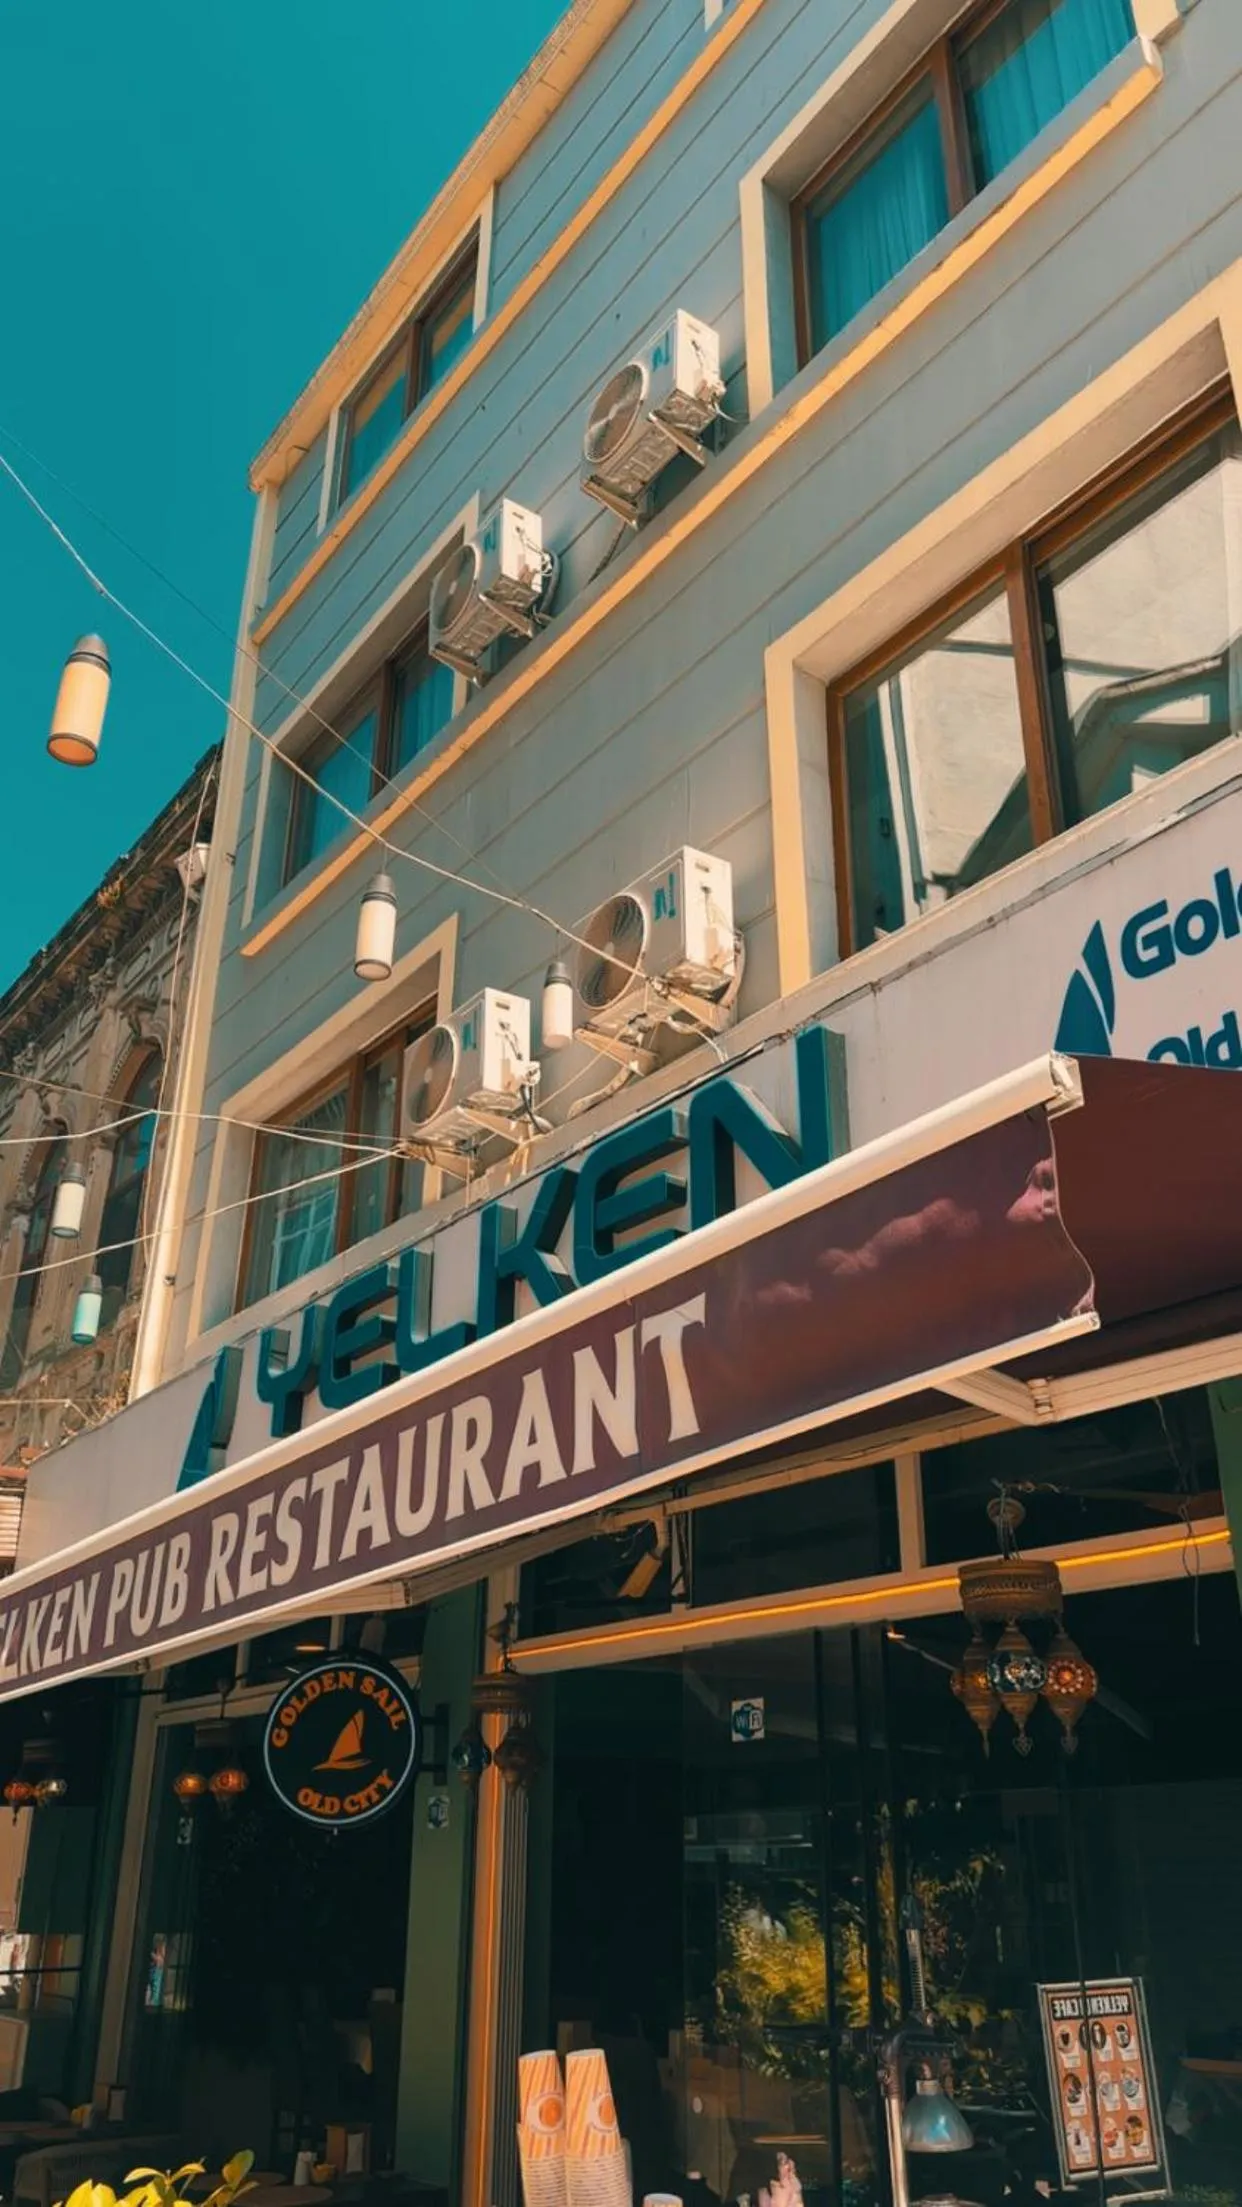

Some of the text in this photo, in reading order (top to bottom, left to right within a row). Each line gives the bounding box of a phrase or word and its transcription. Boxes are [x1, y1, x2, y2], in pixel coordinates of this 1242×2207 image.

[1121, 867, 1242, 980] Gol
[256, 1023, 846, 1438] YELKEN
[104, 1531, 191, 1648] PUB
[201, 1292, 706, 1614] RESTAURANT
[272, 1671, 406, 1748] GOLDEN SAIL
[297, 1786, 341, 1815] OLD
[343, 1768, 394, 1815] CITY
